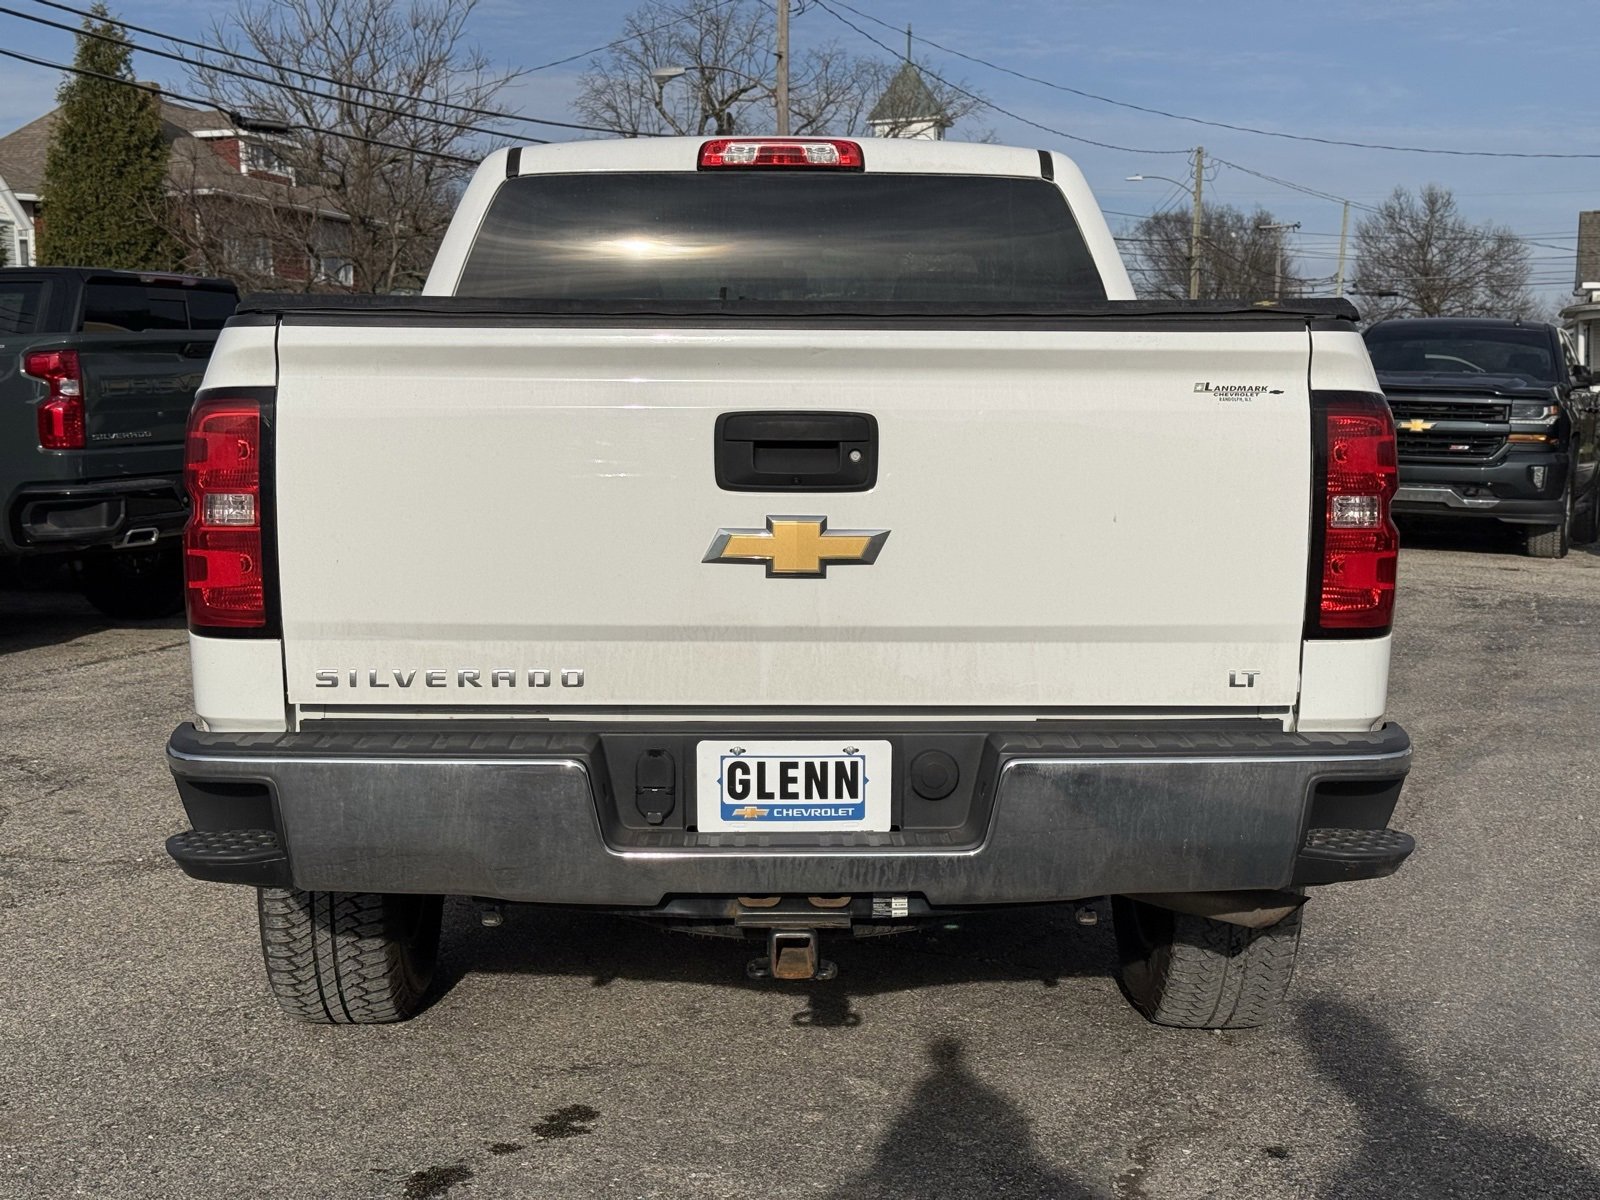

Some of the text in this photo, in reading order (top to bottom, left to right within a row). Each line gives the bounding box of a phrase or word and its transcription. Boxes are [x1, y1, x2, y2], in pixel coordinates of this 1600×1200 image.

[1204, 382, 1268, 391] LANDMARK
[91, 431, 152, 441] SILVERADO
[315, 669, 584, 688] SILVERADO
[1229, 670, 1260, 687] LT
[727, 761, 859, 800] GLENN
[773, 807, 855, 817] CHEVROLET
